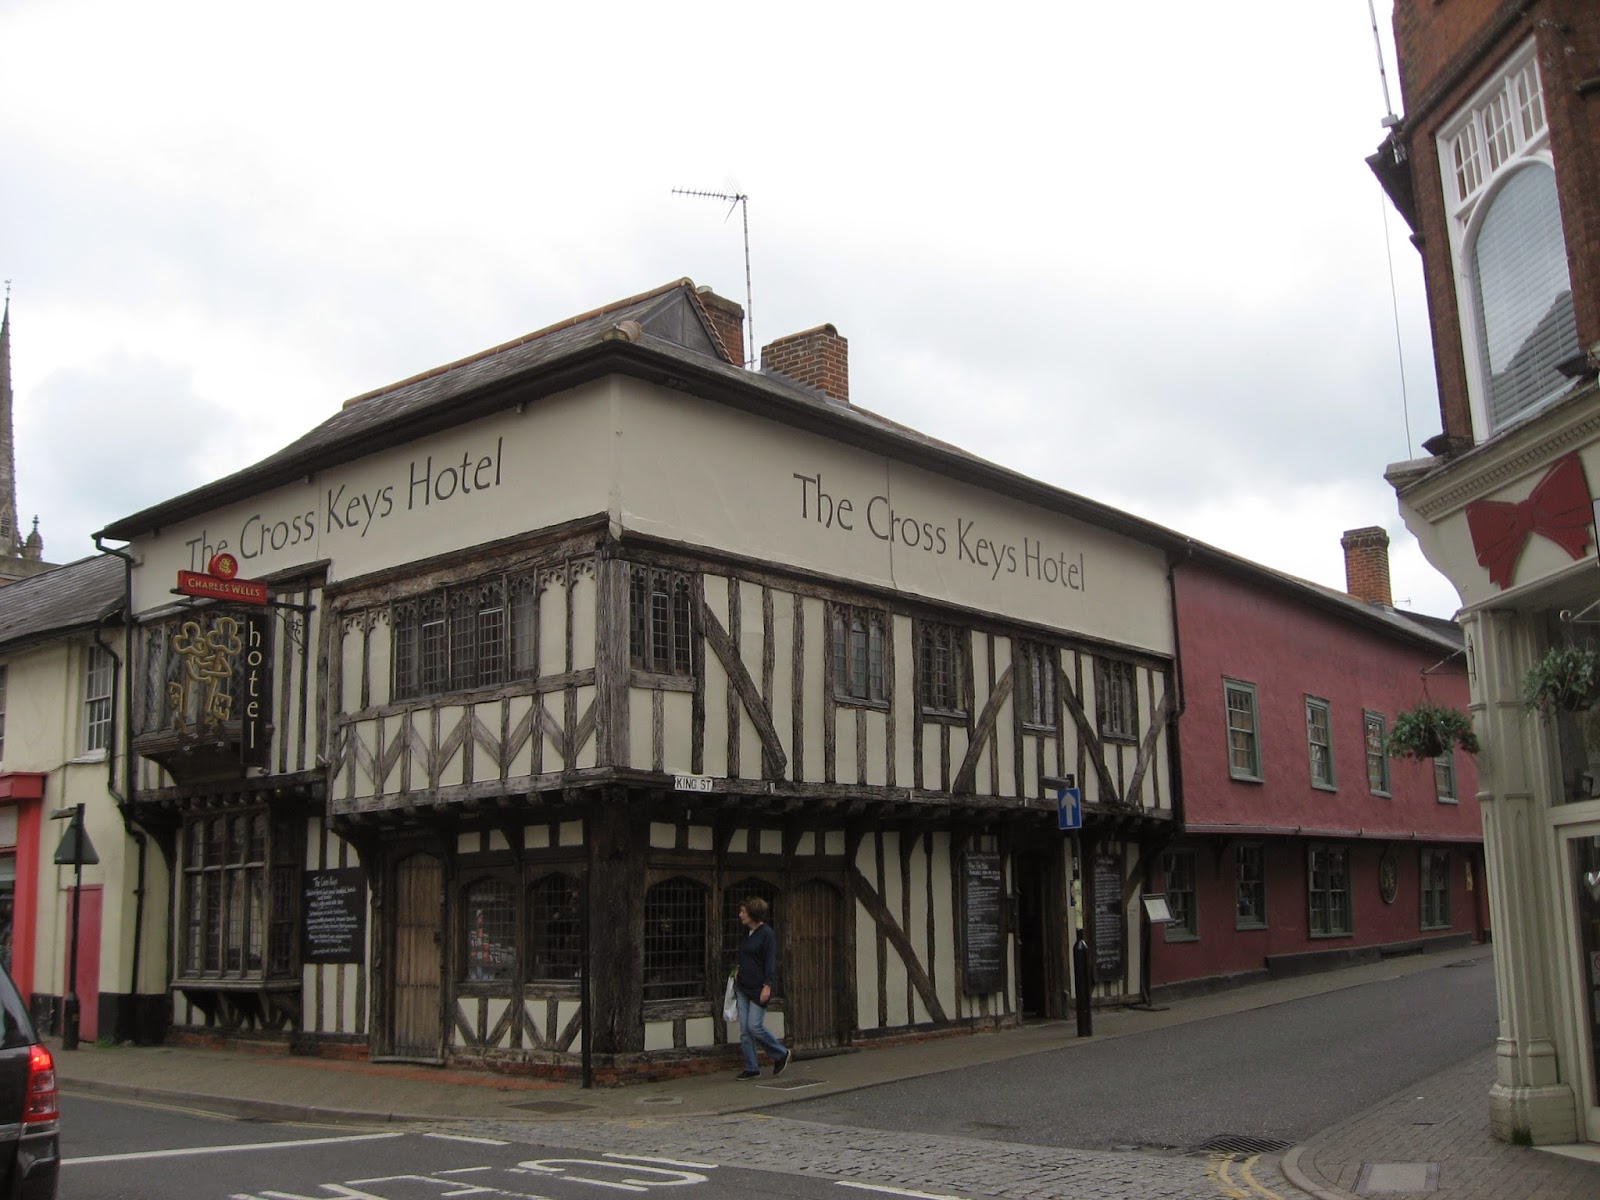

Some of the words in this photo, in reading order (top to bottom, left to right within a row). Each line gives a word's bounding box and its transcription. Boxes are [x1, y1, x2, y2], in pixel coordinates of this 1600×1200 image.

[240, 514, 315, 559] Cross
[326, 484, 393, 537] Keys
[408, 436, 502, 510] Hotel
[793, 472, 853, 530] The
[866, 495, 946, 554] Cross
[957, 518, 1017, 581] Keys
[1024, 537, 1085, 592] Hotel
[188, 578, 229, 593] CHARLES
[231, 584, 260, 597] WELLS
[247, 620, 262, 749] hotel
[676, 777, 697, 790] KING
[700, 779, 711, 791] ST
